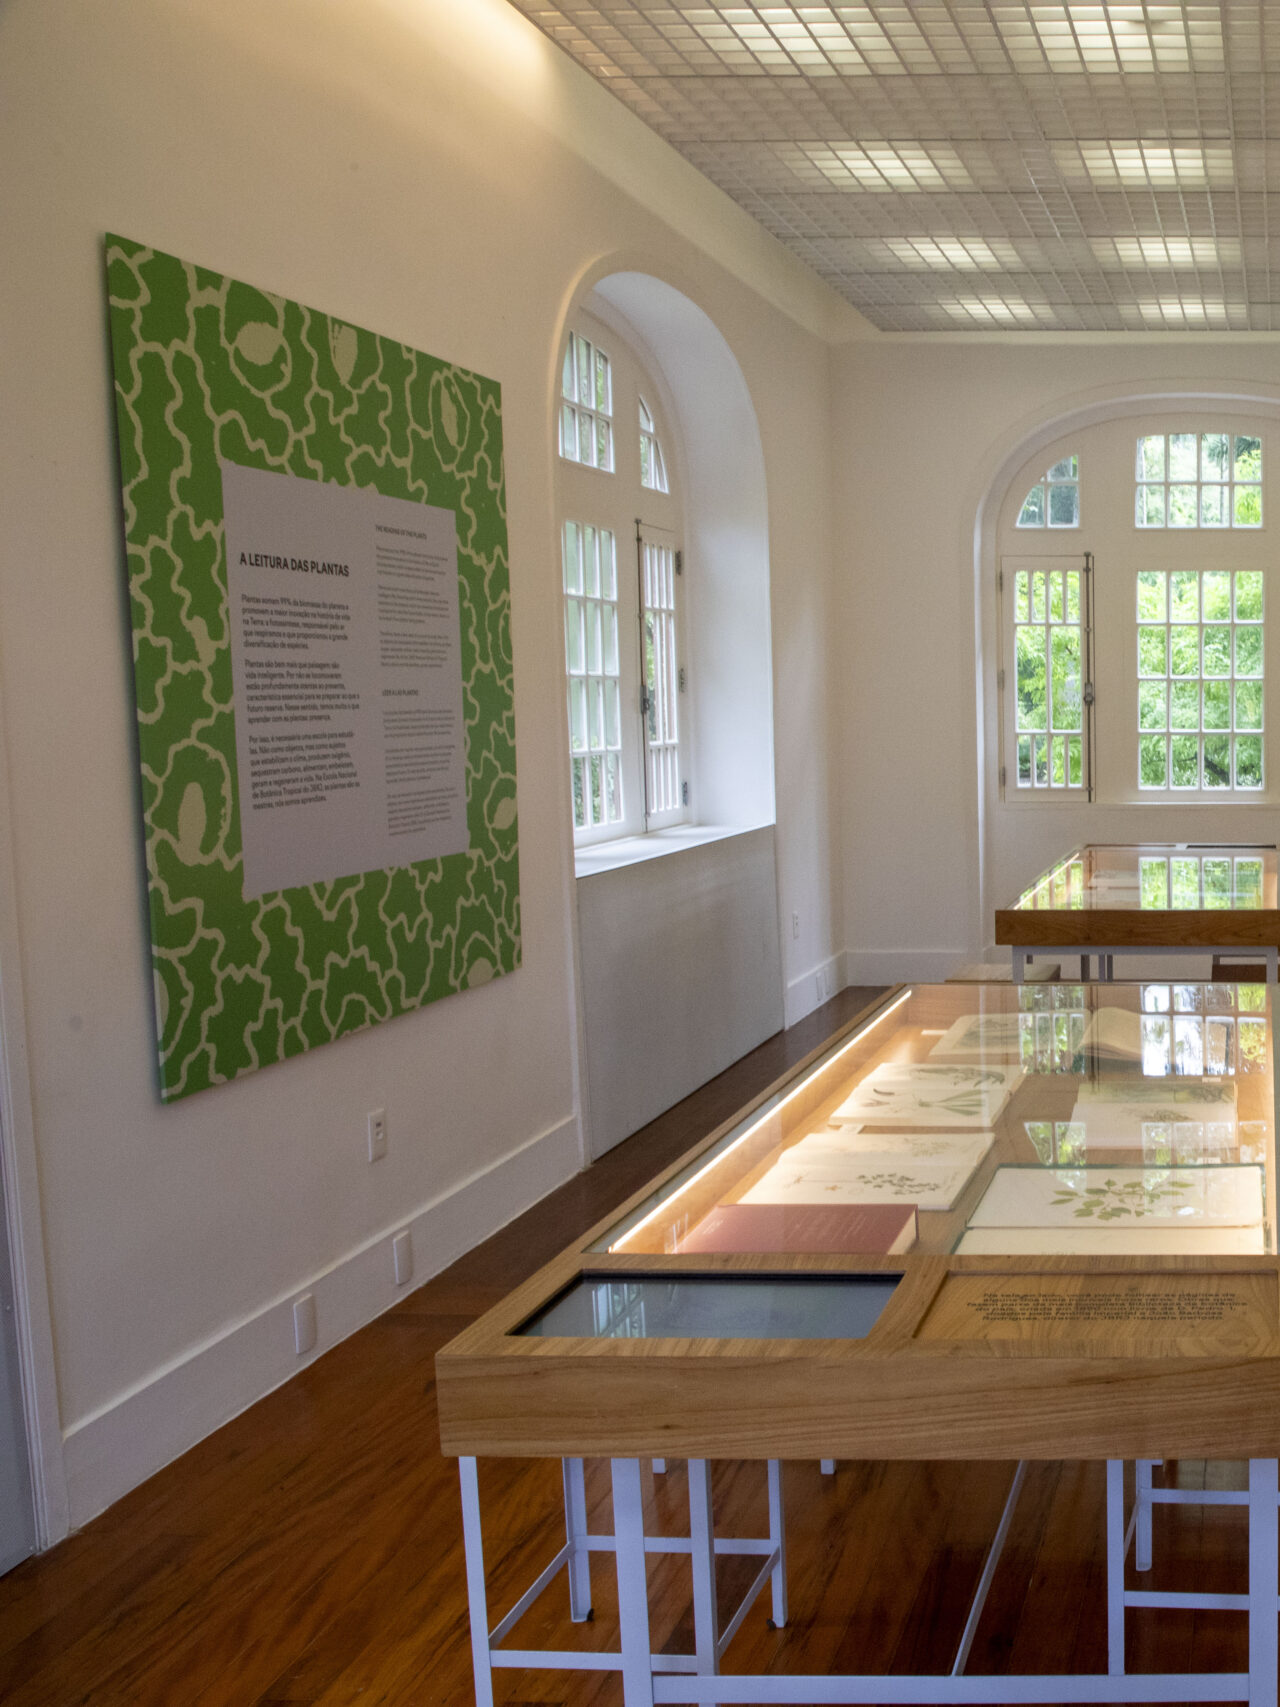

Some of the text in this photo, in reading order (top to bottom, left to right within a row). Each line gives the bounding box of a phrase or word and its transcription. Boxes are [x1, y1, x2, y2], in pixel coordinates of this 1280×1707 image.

[240, 552, 350, 577] A LEITURA DAS PLANTAS
